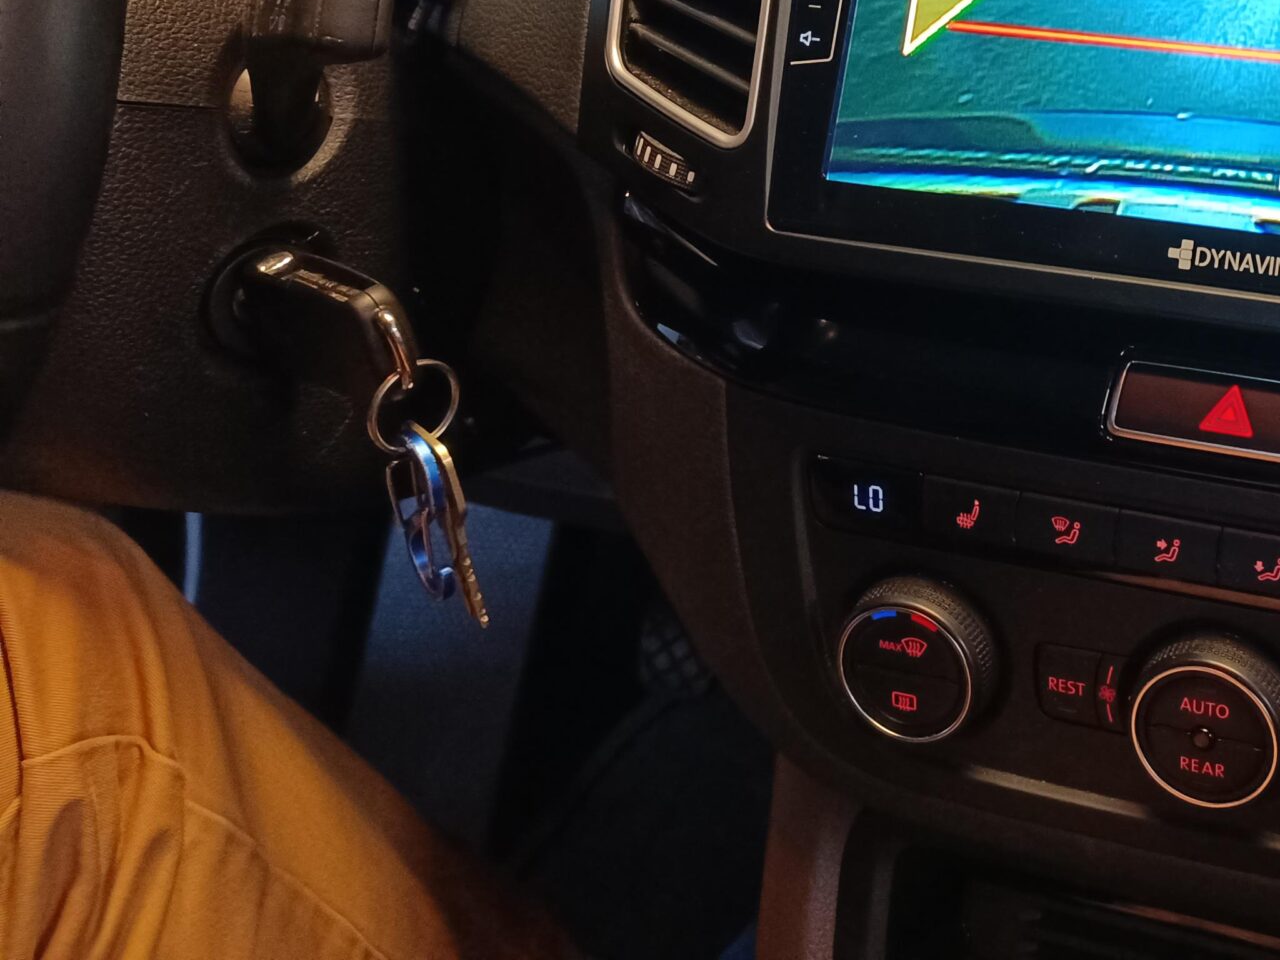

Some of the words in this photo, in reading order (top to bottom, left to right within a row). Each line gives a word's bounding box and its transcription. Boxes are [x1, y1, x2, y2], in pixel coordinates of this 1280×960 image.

[853, 483, 884, 513] LO
[879, 639, 903, 653] MAX
[1047, 676, 1086, 697] REST
[1179, 696, 1231, 720] AUTO
[1179, 755, 1226, 778] REAR
